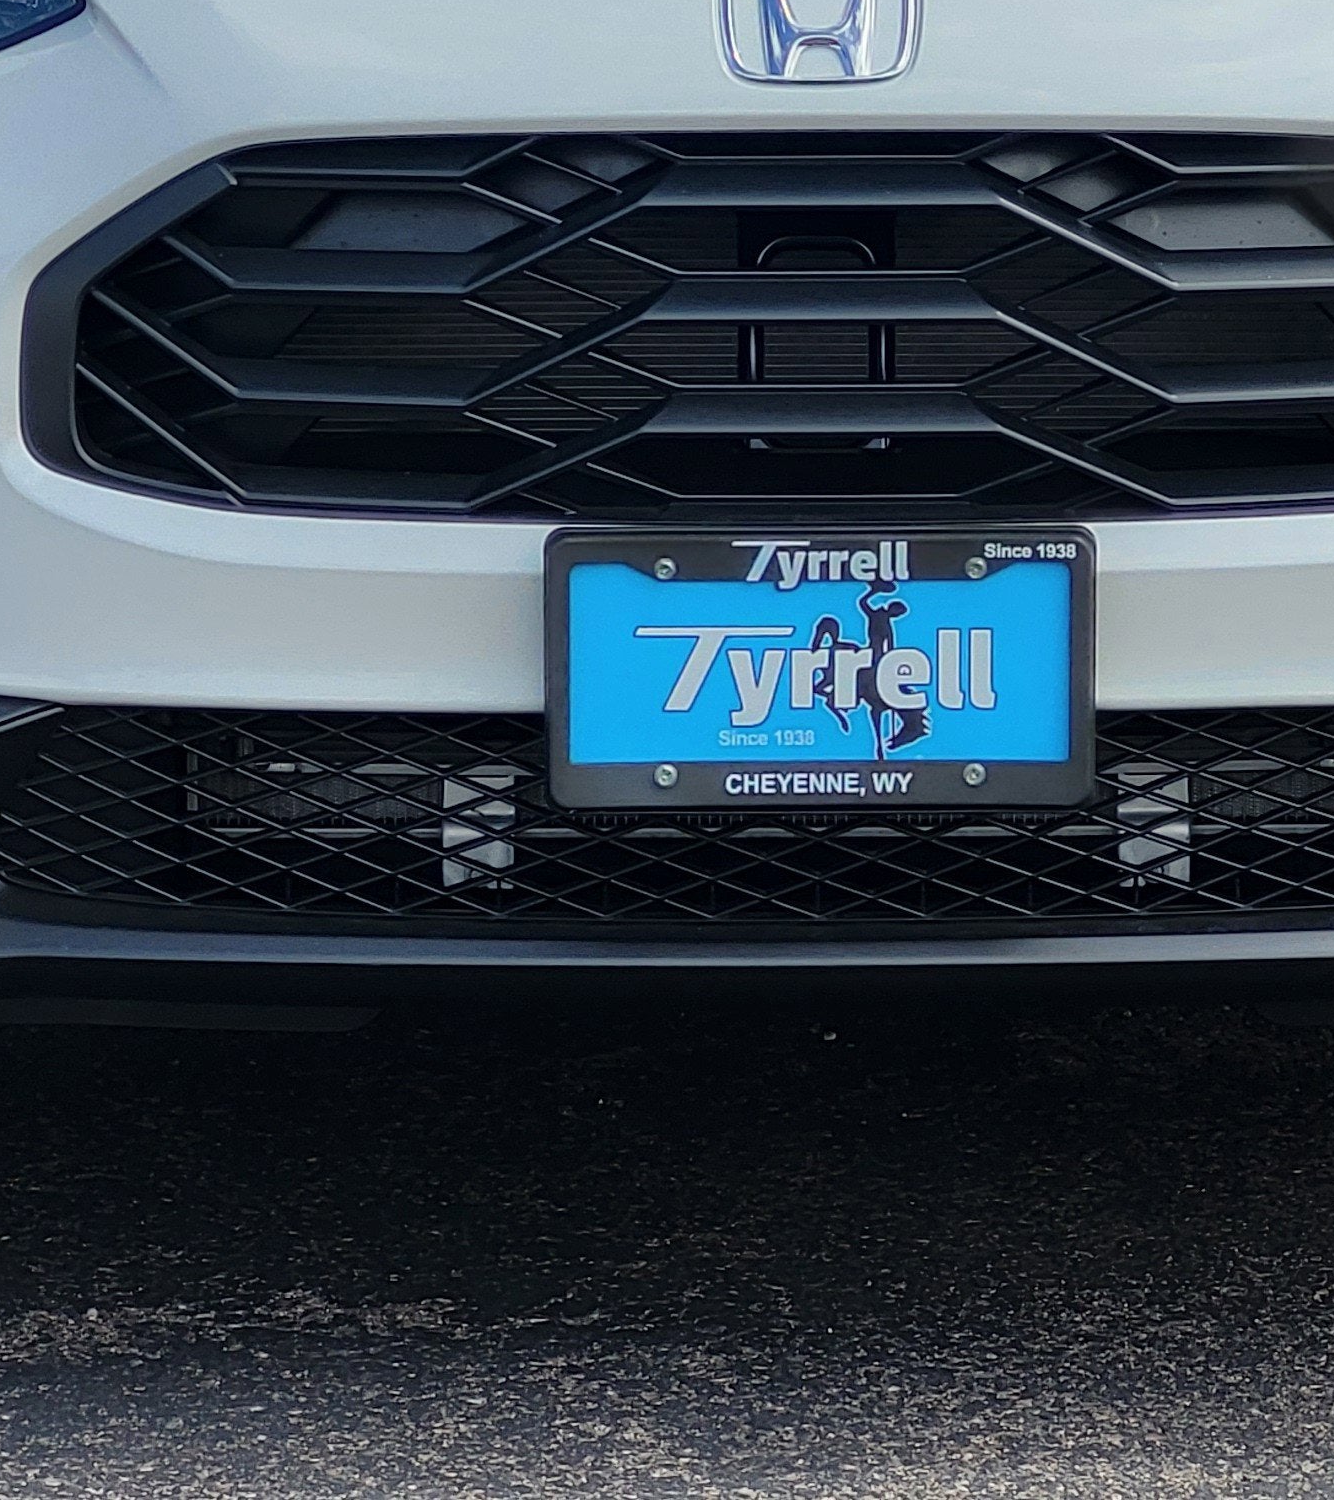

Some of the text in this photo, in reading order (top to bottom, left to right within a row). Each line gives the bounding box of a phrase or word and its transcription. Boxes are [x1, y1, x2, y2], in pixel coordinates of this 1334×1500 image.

[984, 542, 1077, 559] Since 1938
[730, 540, 910, 590] Tyrrell
[633, 626, 998, 727] Tyrrell
[718, 729, 815, 747] Since 1938
[725, 771, 913, 797] CHEYENNE, WY
